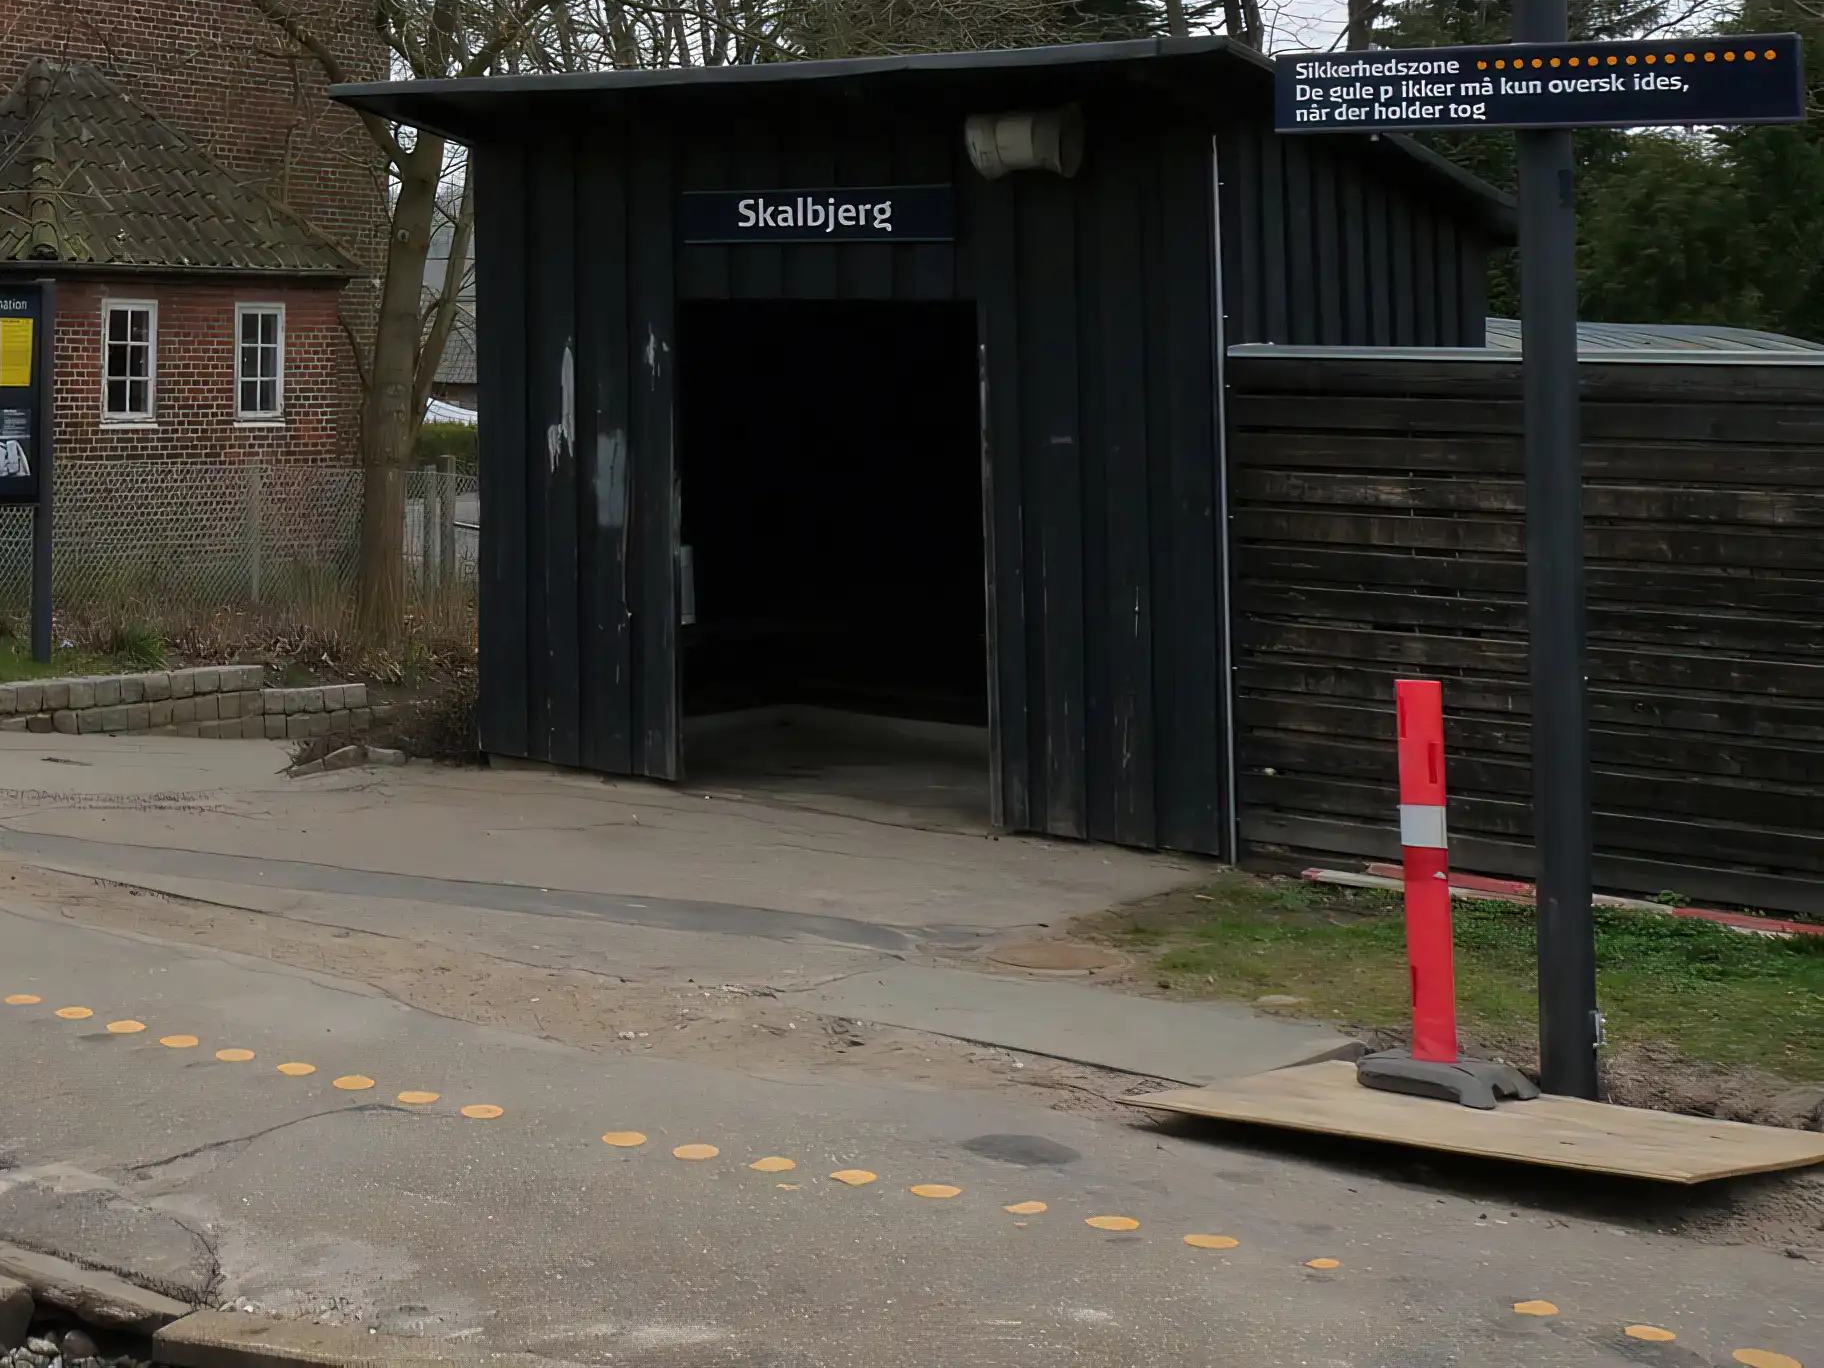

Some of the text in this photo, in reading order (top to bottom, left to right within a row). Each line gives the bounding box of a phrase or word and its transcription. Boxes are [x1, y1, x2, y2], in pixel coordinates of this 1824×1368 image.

[1295, 59, 1460, 79] Sikkerhedszone
[1295, 72, 1690, 102] De gule pikker må kun overskides,
[1295, 101, 1487, 122] når der holder tog
[737, 196, 893, 233] Skalbjerg
